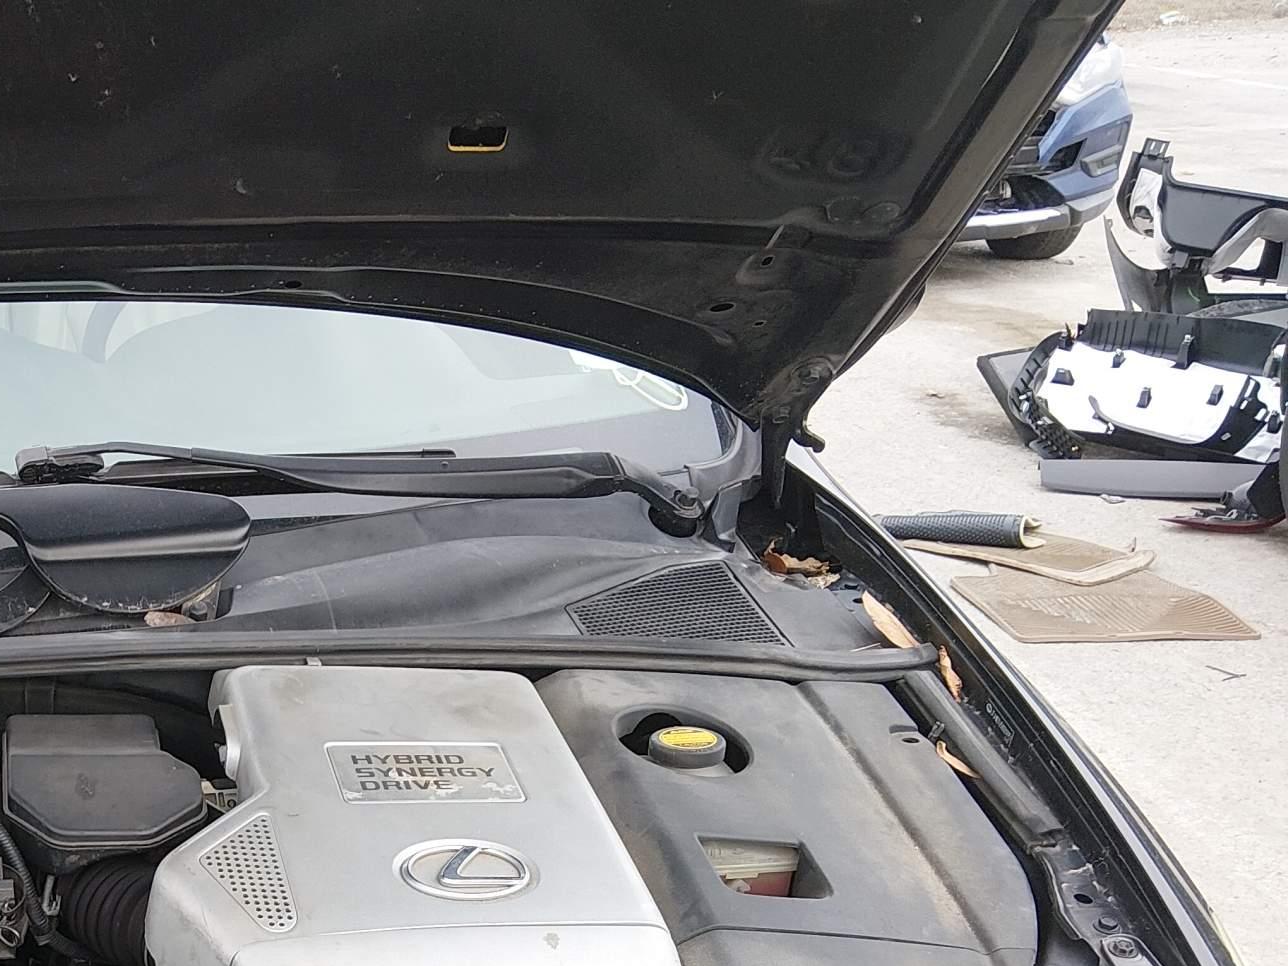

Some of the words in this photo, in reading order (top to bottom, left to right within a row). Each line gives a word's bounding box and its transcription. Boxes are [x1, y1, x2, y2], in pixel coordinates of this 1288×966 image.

[351, 754, 464, 765] HYBRID
[355, 767, 495, 778] SYNERGY
[360, 780, 453, 791] DRIVE
